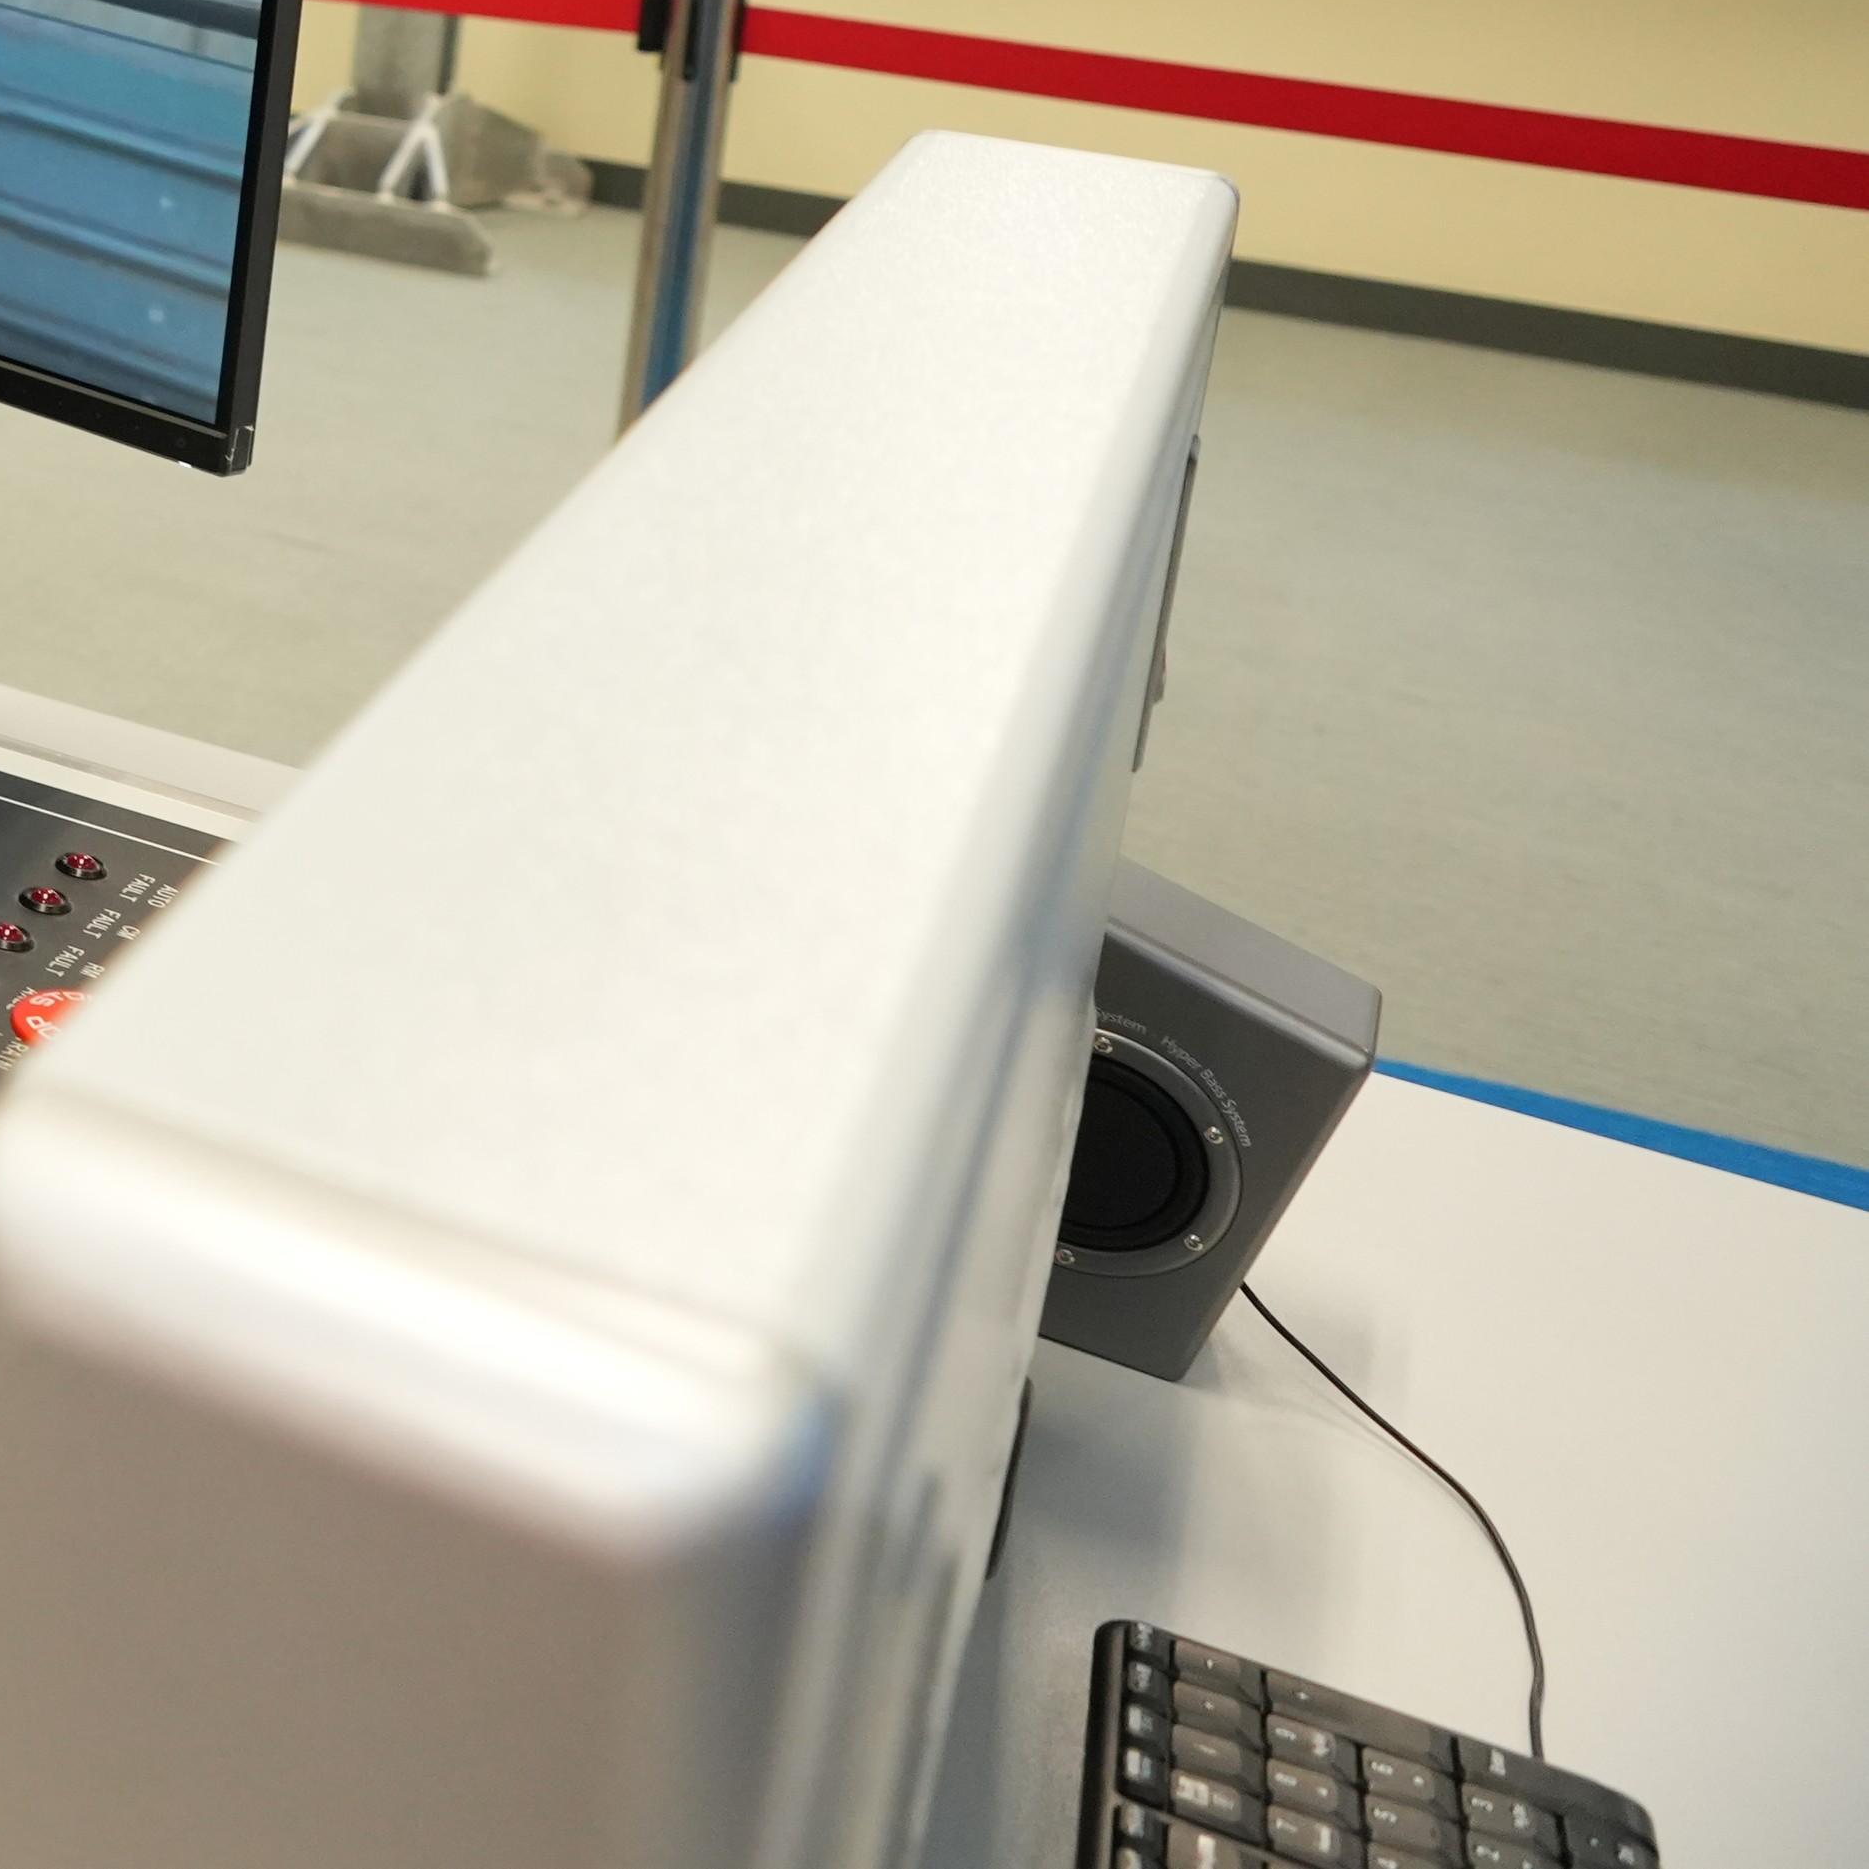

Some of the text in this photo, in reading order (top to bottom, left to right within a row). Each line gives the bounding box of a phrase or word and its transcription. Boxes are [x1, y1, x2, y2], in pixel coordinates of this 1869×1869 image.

[118, 873, 156, 904] FAULT
[147, 883, 180, 909] AUTO
[82, 907, 122, 940] FAULT
[44, 944, 85, 978] FAULT
[79, 961, 106, 980] RM
[1160, 1035, 1252, 1148] Hyper Bass System
